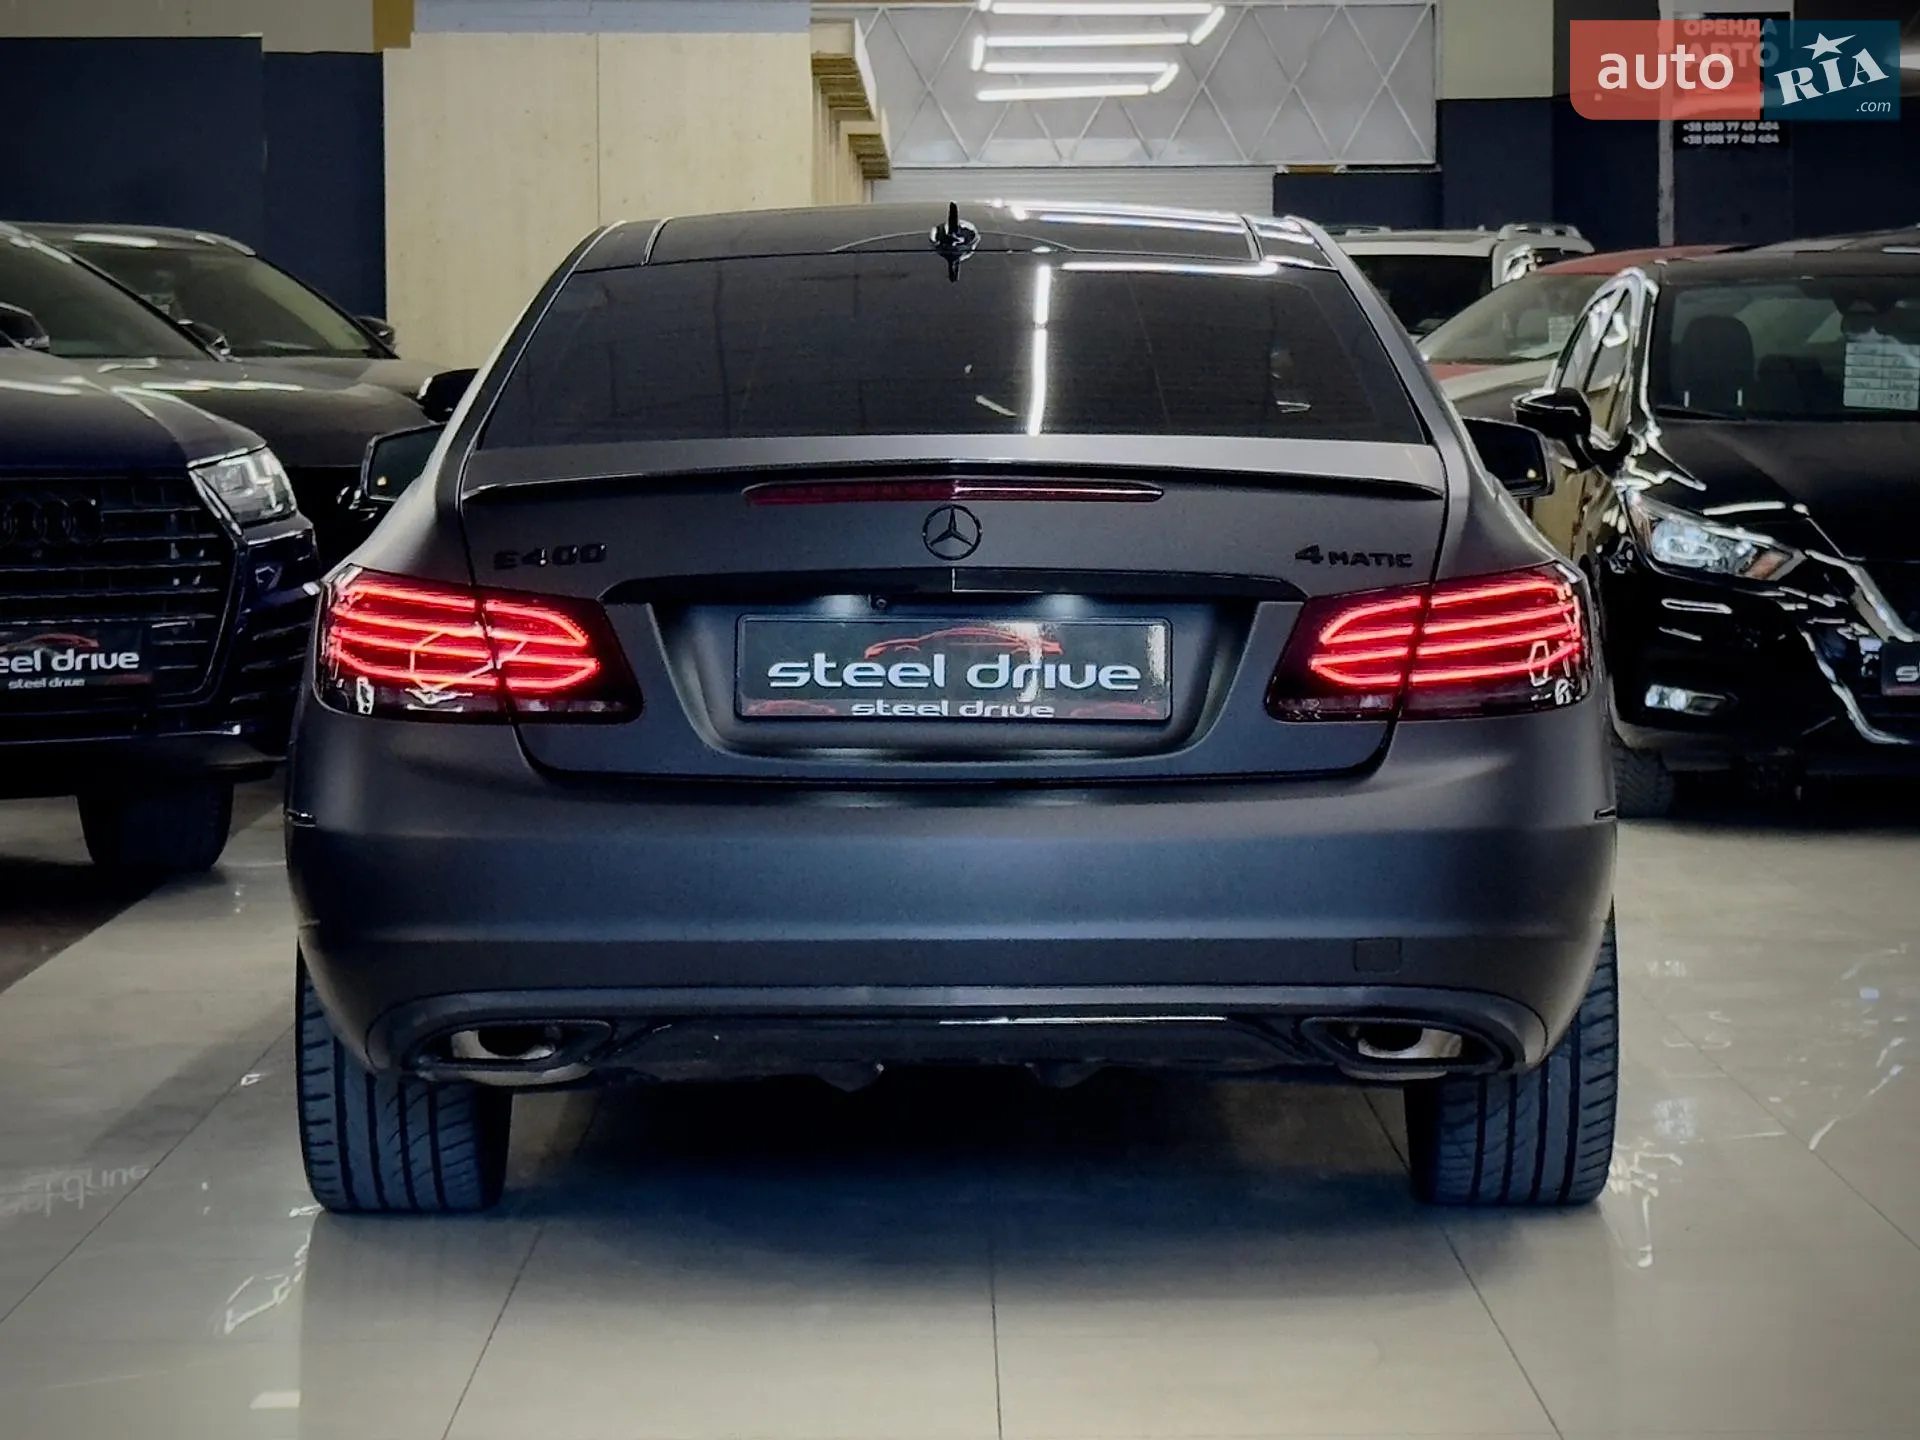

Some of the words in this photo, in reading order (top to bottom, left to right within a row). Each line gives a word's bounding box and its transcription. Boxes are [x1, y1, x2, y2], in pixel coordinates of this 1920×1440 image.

[1683, 18, 1778, 38] ОРЕНДА
[1685, 41, 1780, 68] АВТО
[1725, 121, 1740, 132] 77
[1725, 133, 1740, 144] 77
[493, 543, 607, 571] E400
[51, 648, 140, 671] drive
[768, 652, 945, 689] steel
[966, 654, 1142, 691] drive
[8, 678, 47, 690] steel
[49, 677, 86, 688] drive
[851, 700, 949, 717] steel
[959, 700, 1055, 718] drive
